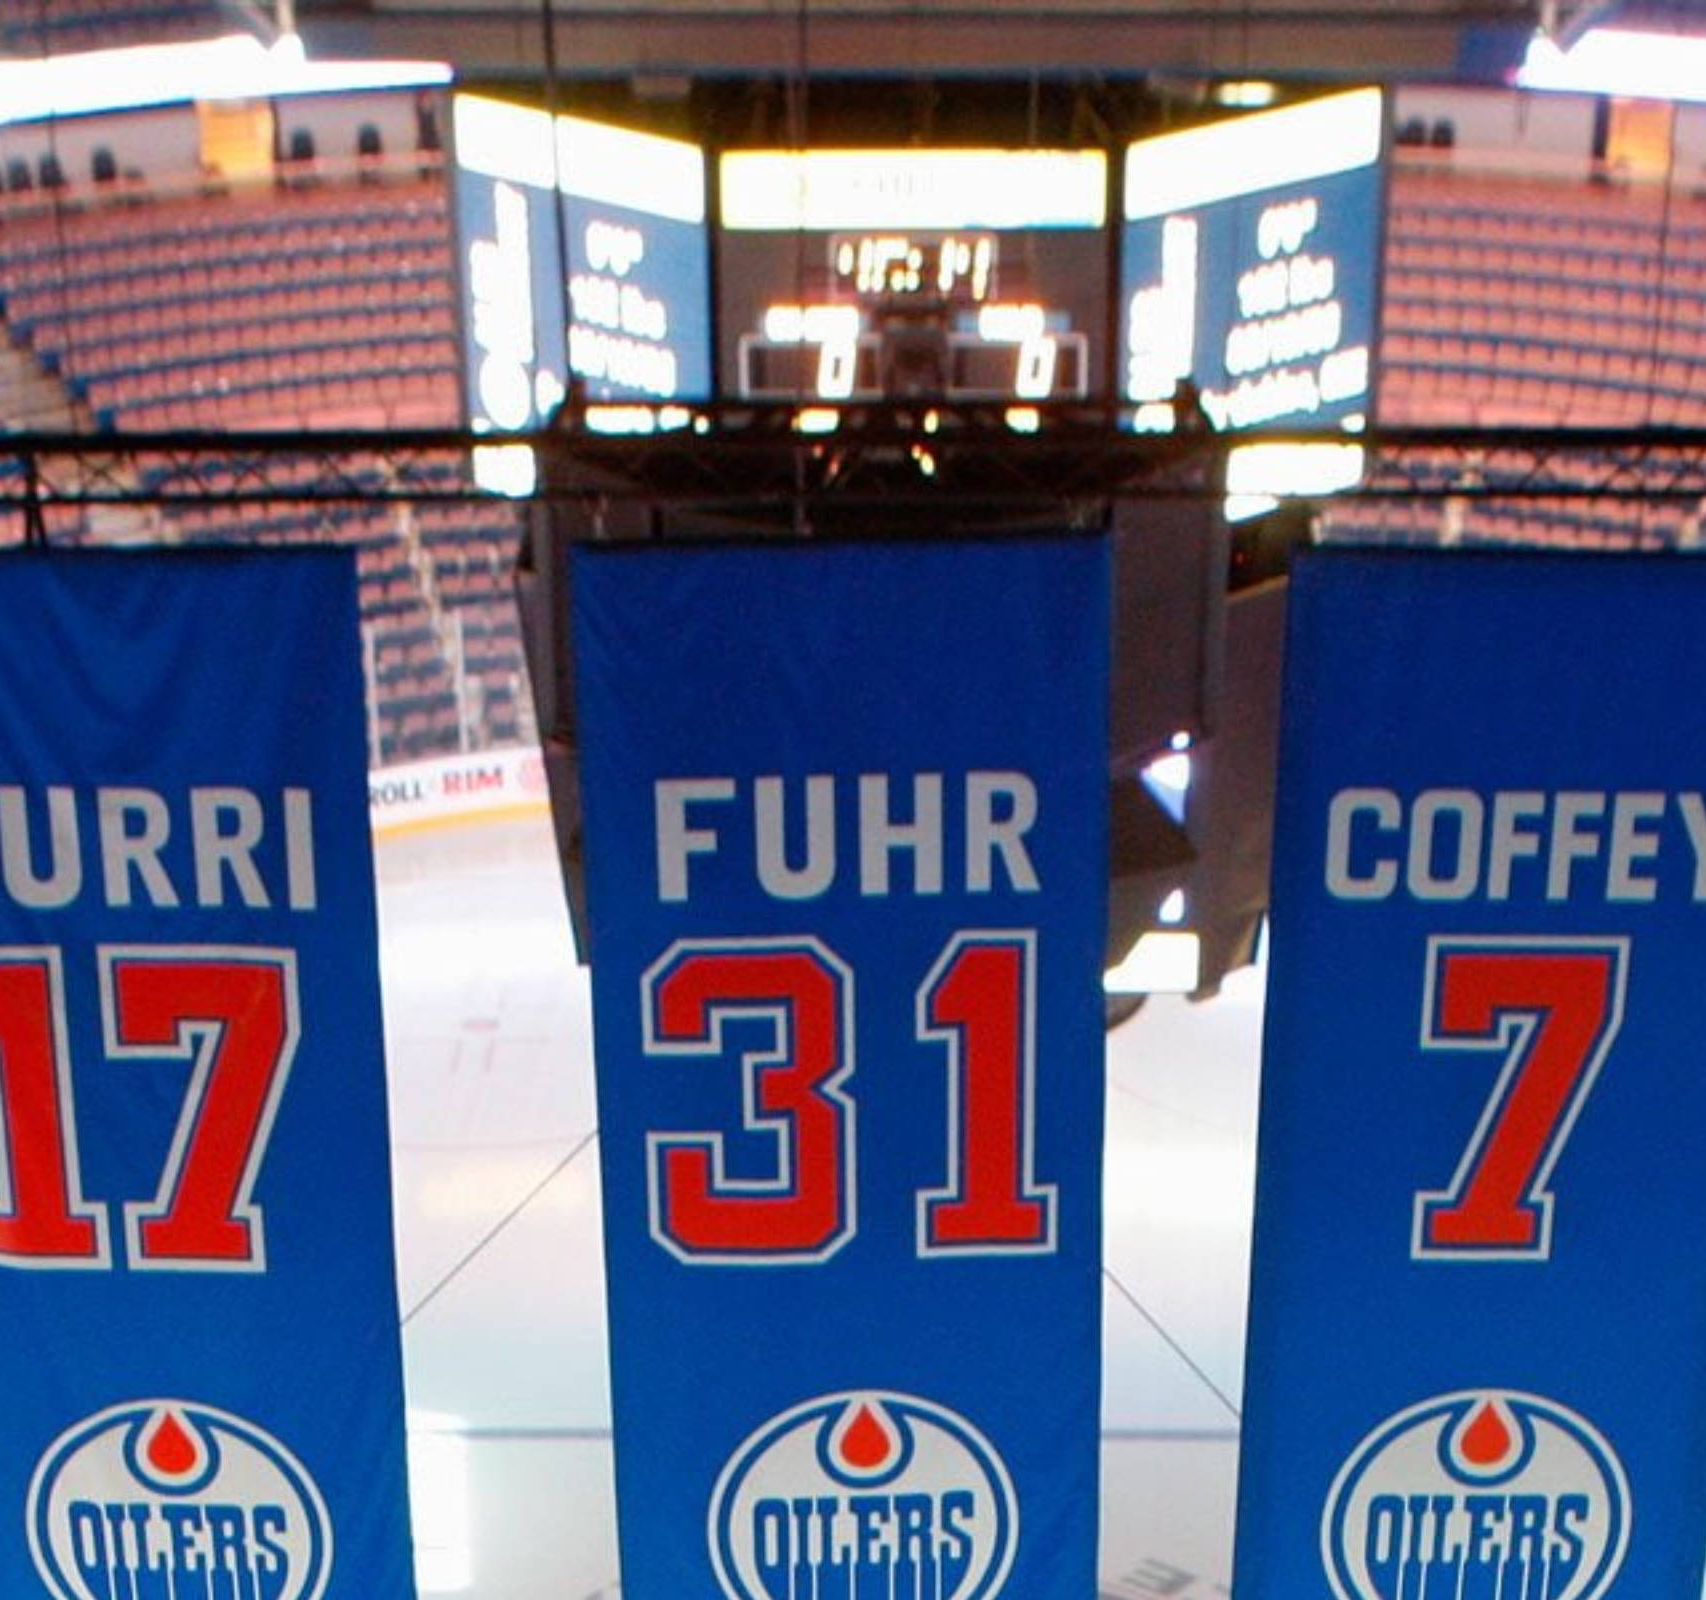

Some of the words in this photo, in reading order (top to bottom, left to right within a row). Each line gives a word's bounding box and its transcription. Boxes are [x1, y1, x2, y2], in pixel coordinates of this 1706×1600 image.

[654, 770, 1042, 903] FUHR
[640, 928, 1059, 1266] 31
[1409, 934, 1632, 1262] 7
[67, 1498, 291, 1597] OILERS
[751, 1487, 976, 1592] OILERS
[1364, 1493, 1590, 1592] OILERS
